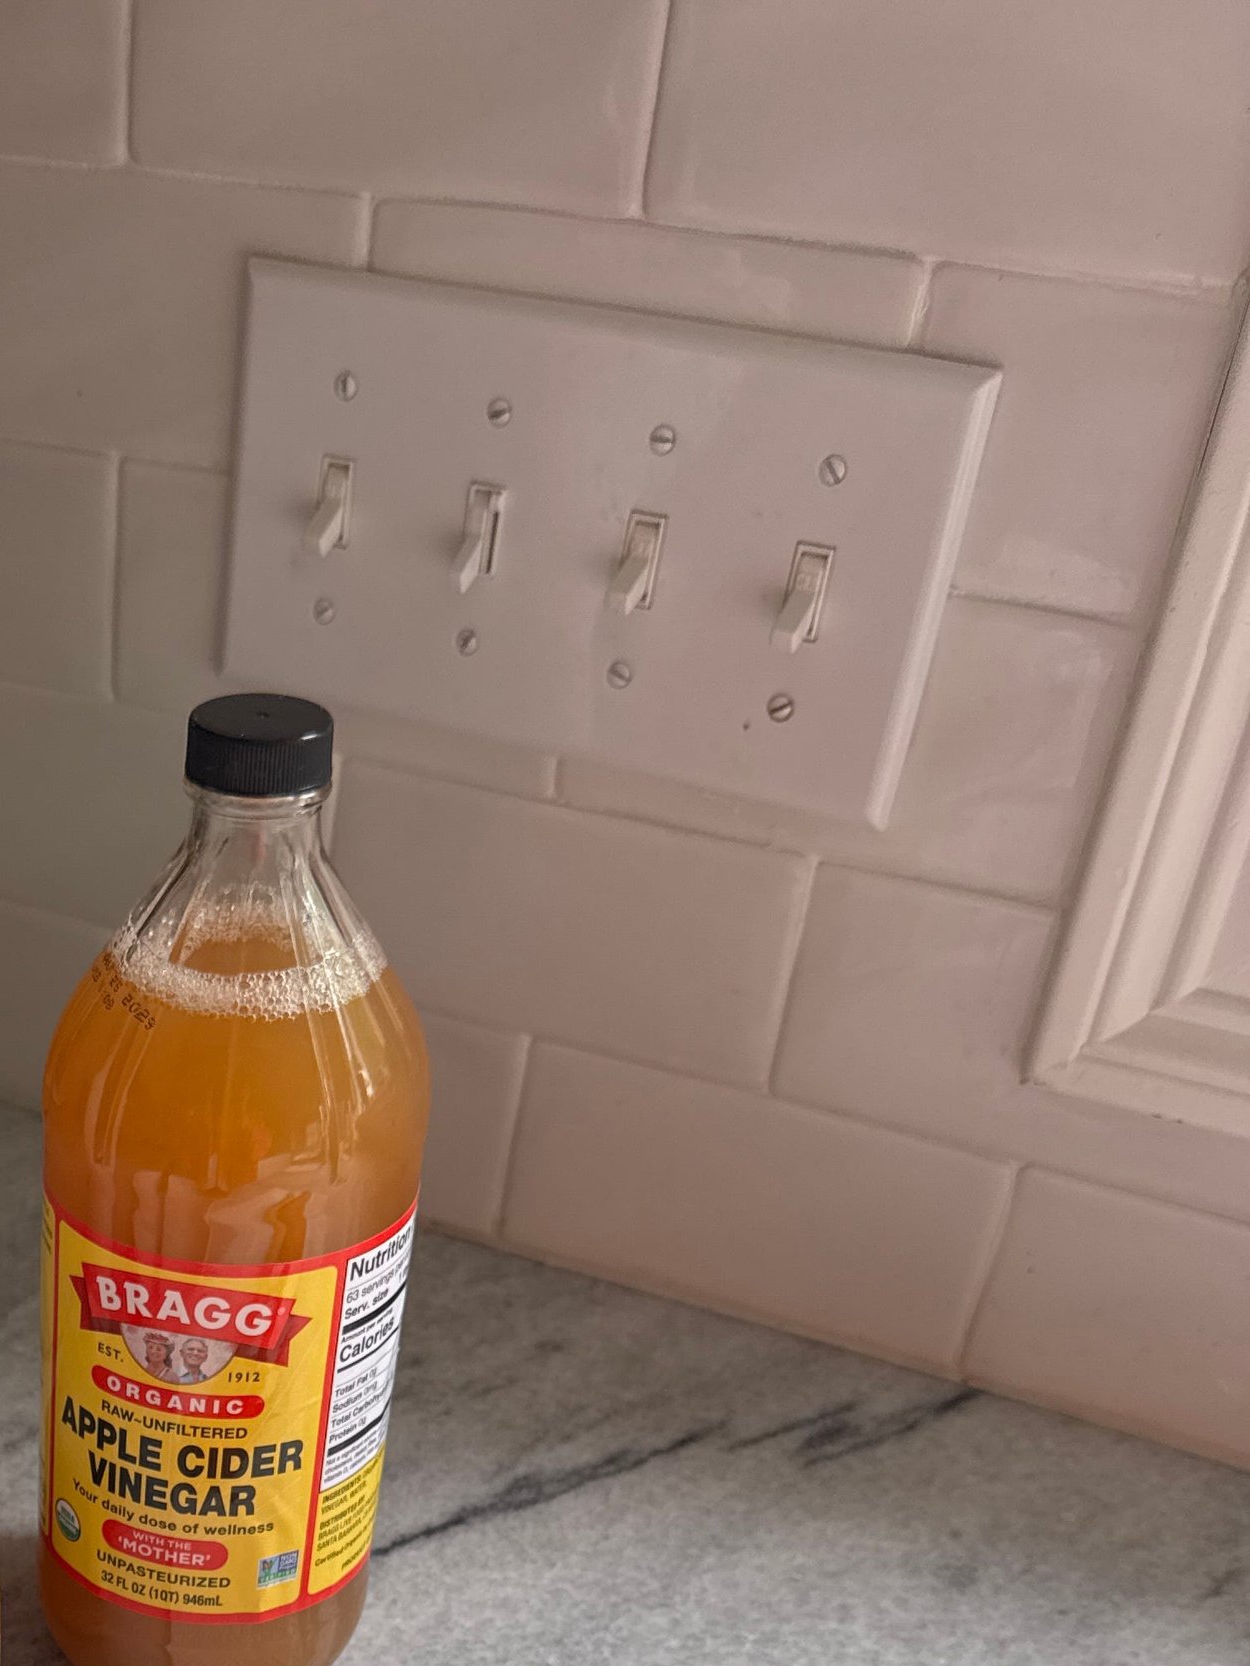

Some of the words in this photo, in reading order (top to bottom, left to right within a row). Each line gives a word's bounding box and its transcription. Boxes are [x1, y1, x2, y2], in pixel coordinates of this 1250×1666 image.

[361, 1269, 395, 1298] servings
[96, 1275, 273, 1337] BRAGG
[344, 1301, 370, 1320] Serv.
[372, 1288, 390, 1306] size
[340, 1327, 366, 1344] Amount
[340, 1316, 394, 1363] Calories
[97, 1342, 124, 1363] EST.
[227, 1371, 261, 1383] 1912
[335, 1381, 356, 1398] Total
[356, 1372, 369, 1388] Fat
[106, 1375, 244, 1415] ORGANIC
[332, 1391, 363, 1414] Sodium
[329, 1423, 357, 1445] Protein
[331, 1411, 351, 1429] Total
[61, 1395, 162, 1472] APPLE
[176, 1439, 304, 1480] CIDER
[88, 1449, 256, 1518] VINEGAR
[73, 1478, 98, 1504] Your
[101, 1499, 135, 1521] daily
[139, 1514, 177, 1531] dose
[185, 1523, 199, 1535] of
[204, 1522, 275, 1536] wellness
[132, 1530, 164, 1547] WITH
[167, 1539, 192, 1551] THE
[96, 1548, 231, 1589] UNPASTEURIZED
[101, 1569, 114, 1585] 32
[116, 1575, 129, 1591] FL
[131, 1581, 146, 1596] OZ
[149, 1586, 180, 1605] (1QT)
[182, 1593, 223, 1607] 946mL
